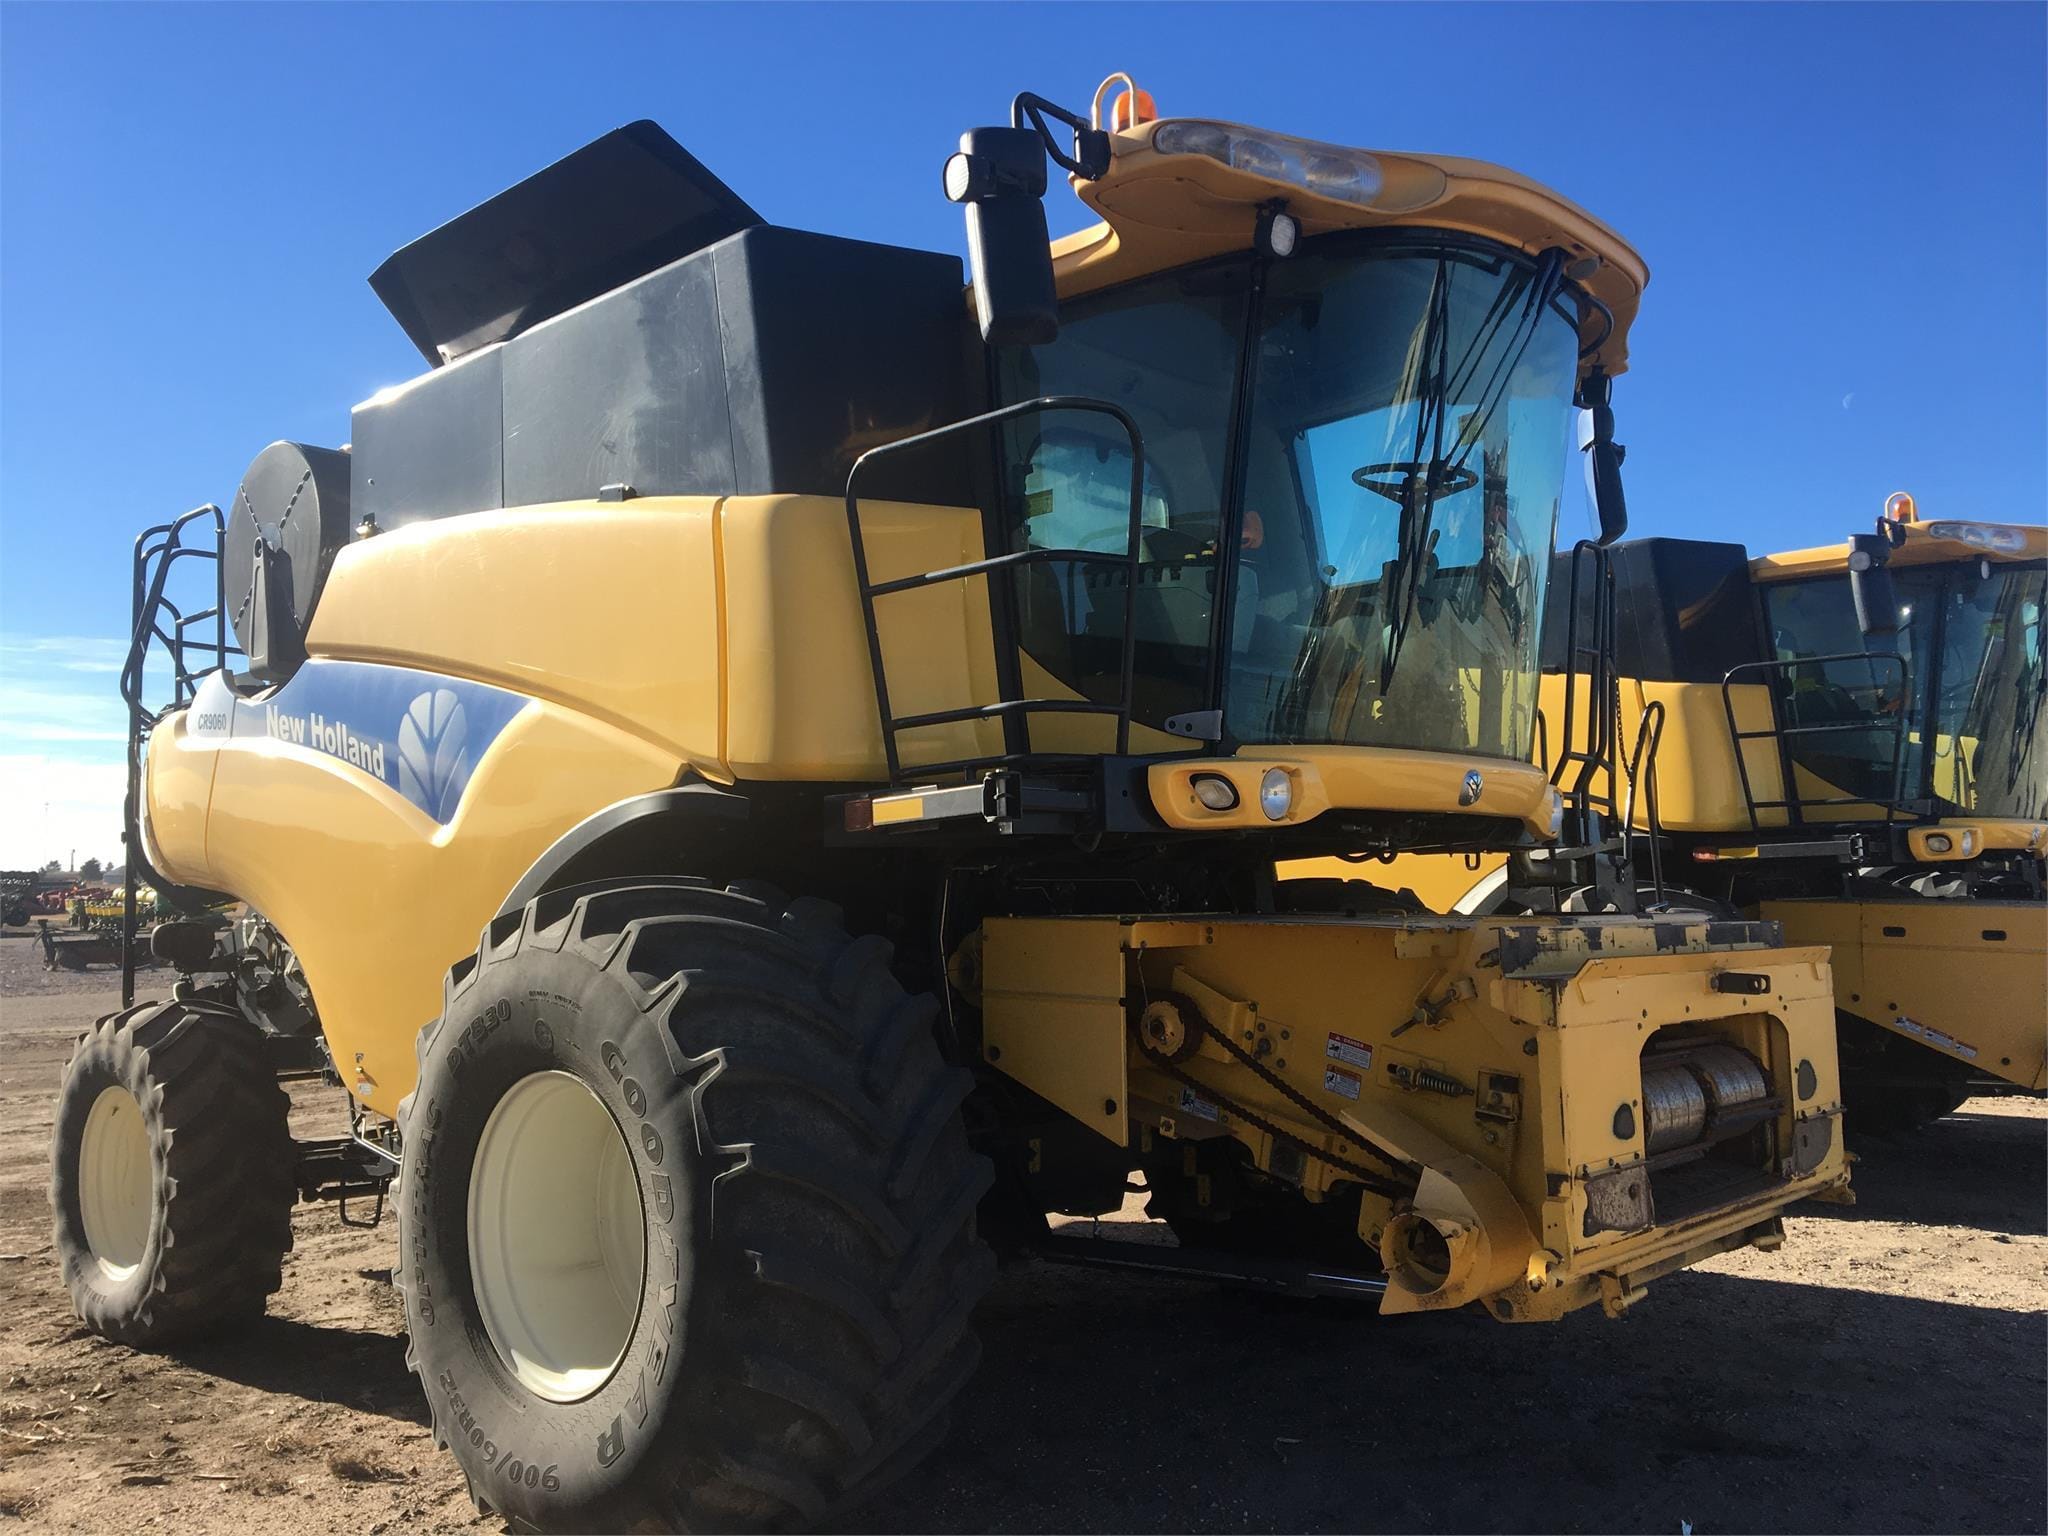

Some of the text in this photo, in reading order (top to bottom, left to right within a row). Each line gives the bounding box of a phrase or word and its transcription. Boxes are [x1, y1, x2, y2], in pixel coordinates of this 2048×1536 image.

[197, 712, 227, 732] CR9060
[265, 703, 386, 781] New Holland
[446, 996, 512, 1077] DT830
[597, 1039, 679, 1468] GOODYEAR
[439, 1367, 561, 1493] 900/60R32
